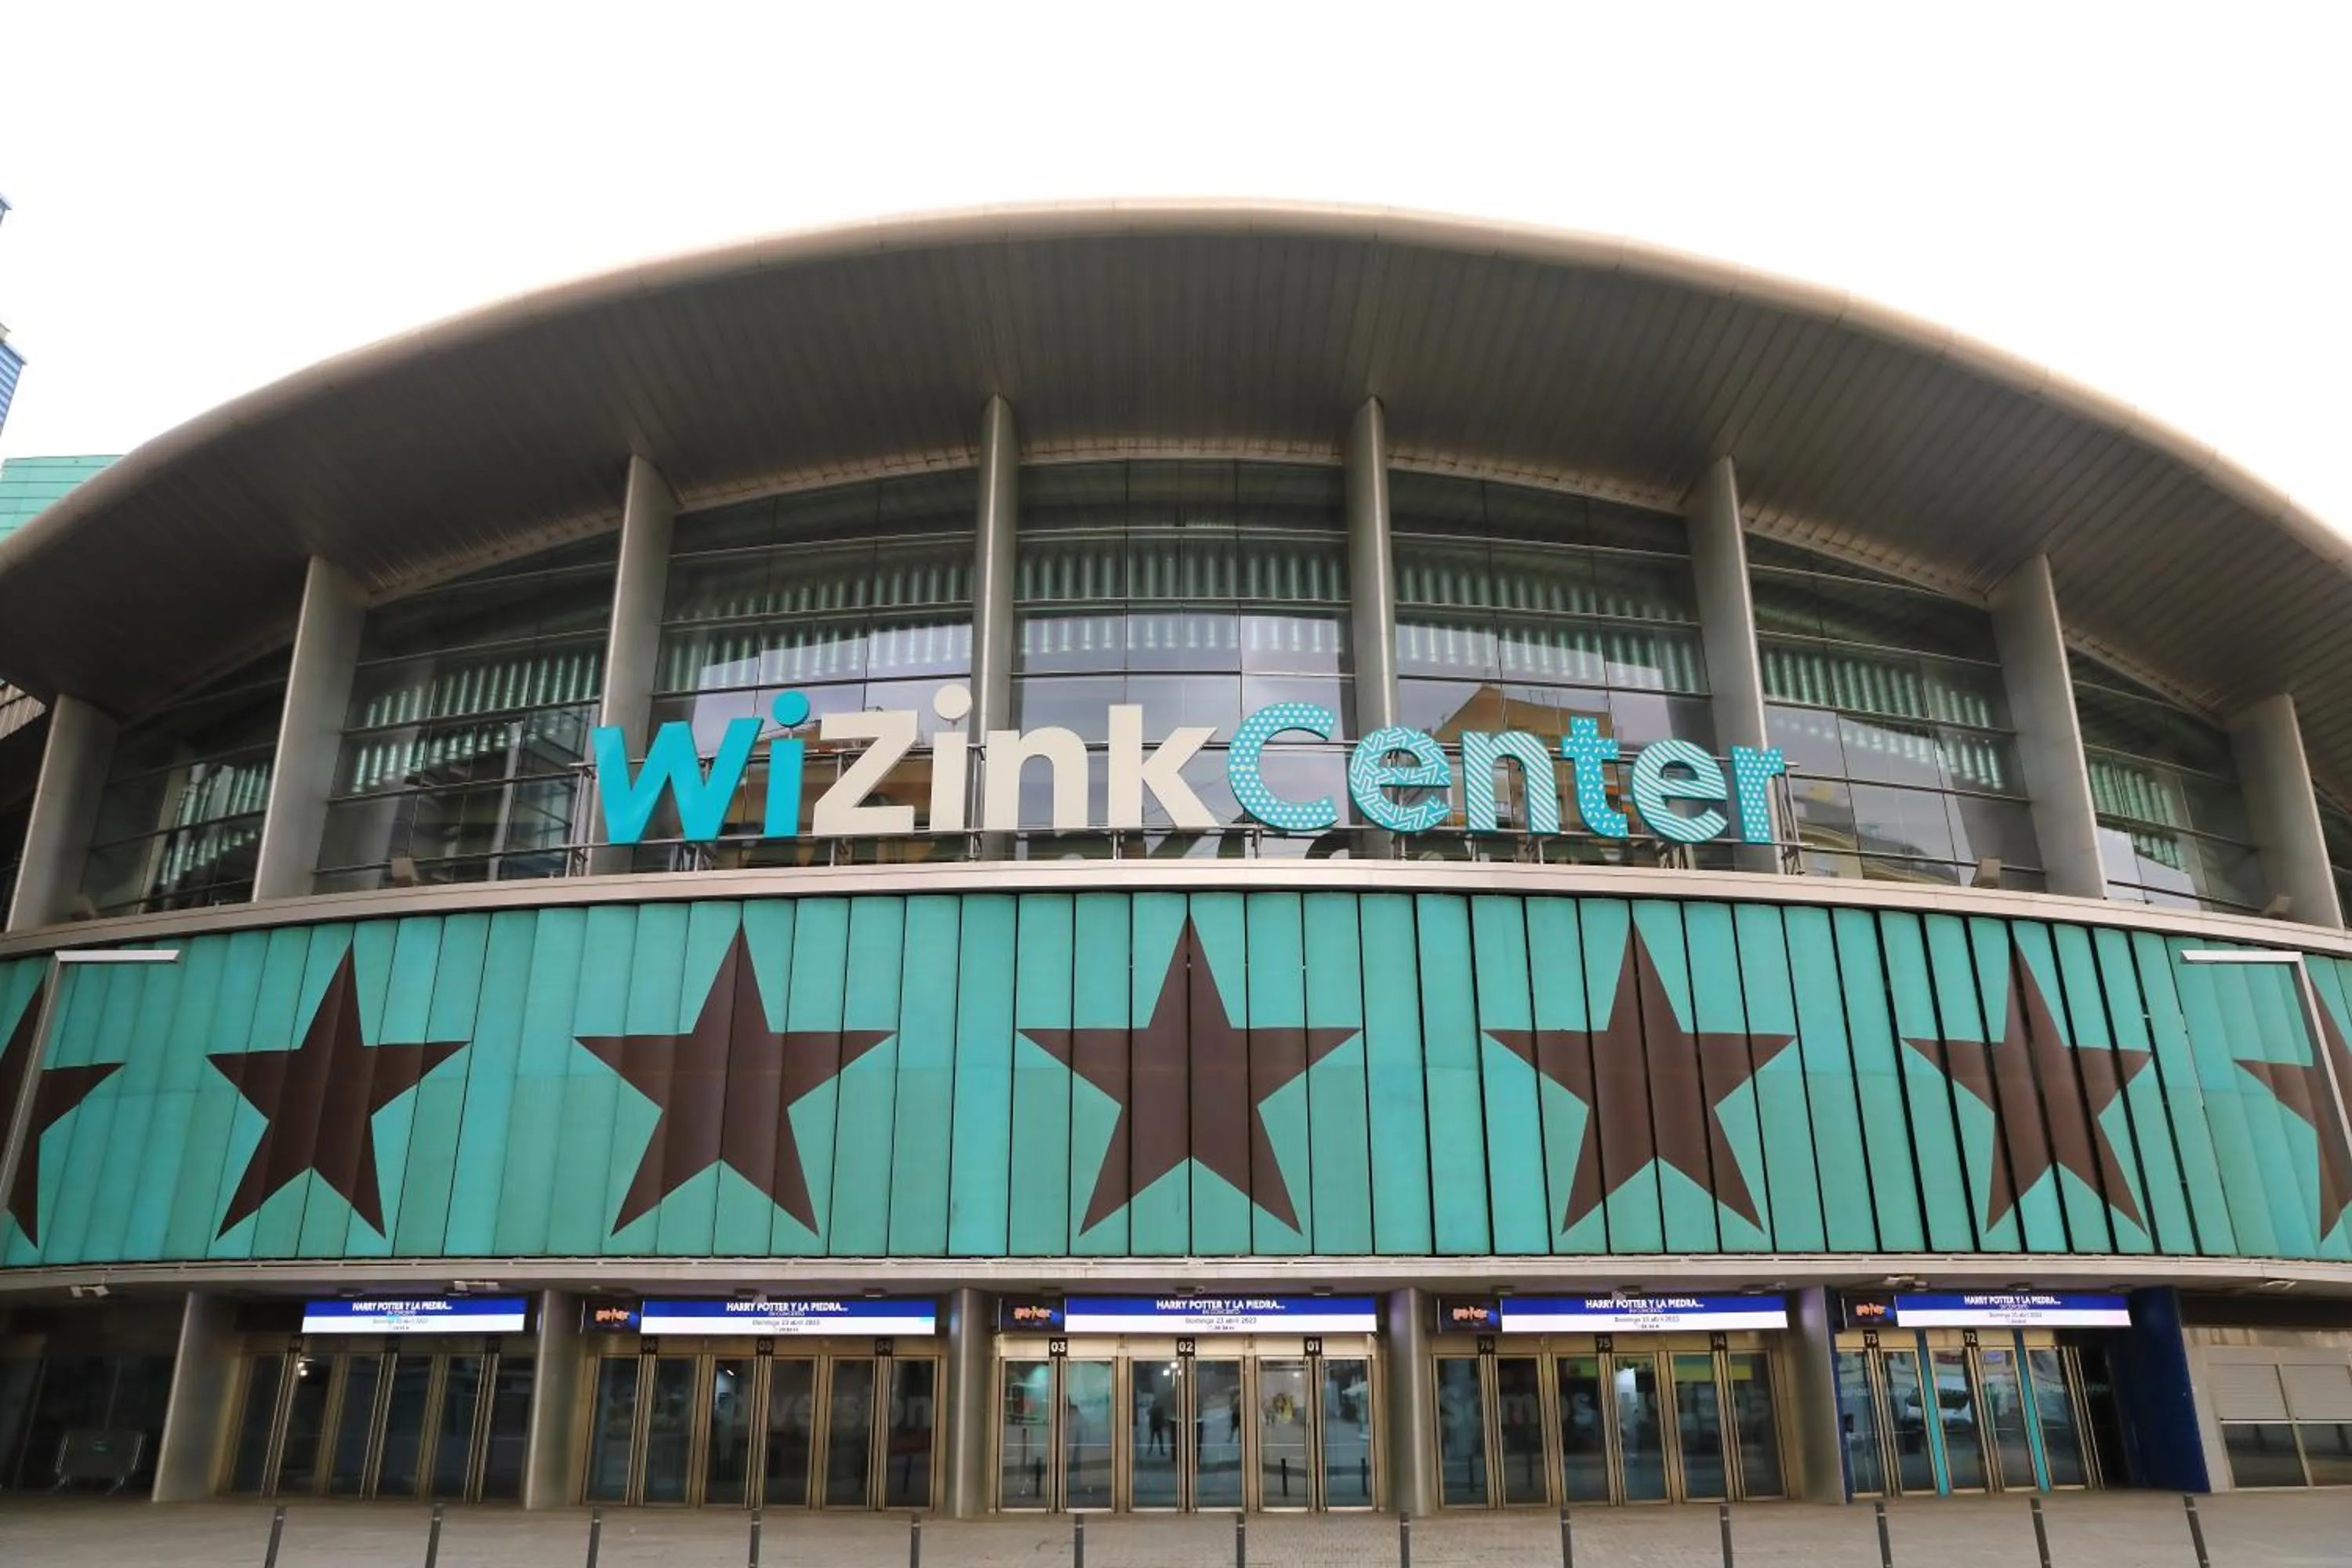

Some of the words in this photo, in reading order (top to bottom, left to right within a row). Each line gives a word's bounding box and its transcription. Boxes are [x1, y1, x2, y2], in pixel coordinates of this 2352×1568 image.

[593, 687, 1218, 844] WiZink
[1227, 701, 1786, 844] Center
[1156, 1300, 1187, 1309] HARRY
[1189, 1300, 1223, 1309] POTTER
[1223, 1300, 1230, 1309] Y
[1232, 1300, 1244, 1309] LA
[1585, 1299, 1614, 1308] HARRY
[1616, 1299, 1649, 1308] POTTER
[1650, 1299, 1656, 1308] Y
[1656, 1299, 1668, 1308] LA
[1964, 1295, 1987, 1305] HARRY
[1989, 1295, 2015, 1305] POTTER
[2015, 1295, 2020, 1304] Y
[2021, 1295, 2031, 1304] LA
[352, 1301, 377, 1312] HARRY
[377, 1301, 404, 1311] POTTER
[405, 1301, 411, 1310] Y
[412, 1301, 421, 1310] LA
[727, 1302, 756, 1312] HARRY
[757, 1302, 789, 1312] POTTER
[790, 1302, 798, 1311] Y
[798, 1302, 810, 1311] LA
[1598, 1337, 1611, 1348] 75
[1713, 1335, 1726, 1346] 74
[1865, 1334, 1878, 1344] 73
[1964, 1332, 1976, 1343] 72
[758, 1340, 772, 1350] 05
[877, 1341, 891, 1351] 04
[1051, 1341, 1065, 1352] 03
[1178, 1341, 1193, 1352] 02
[1307, 1341, 1319, 1351] 01
